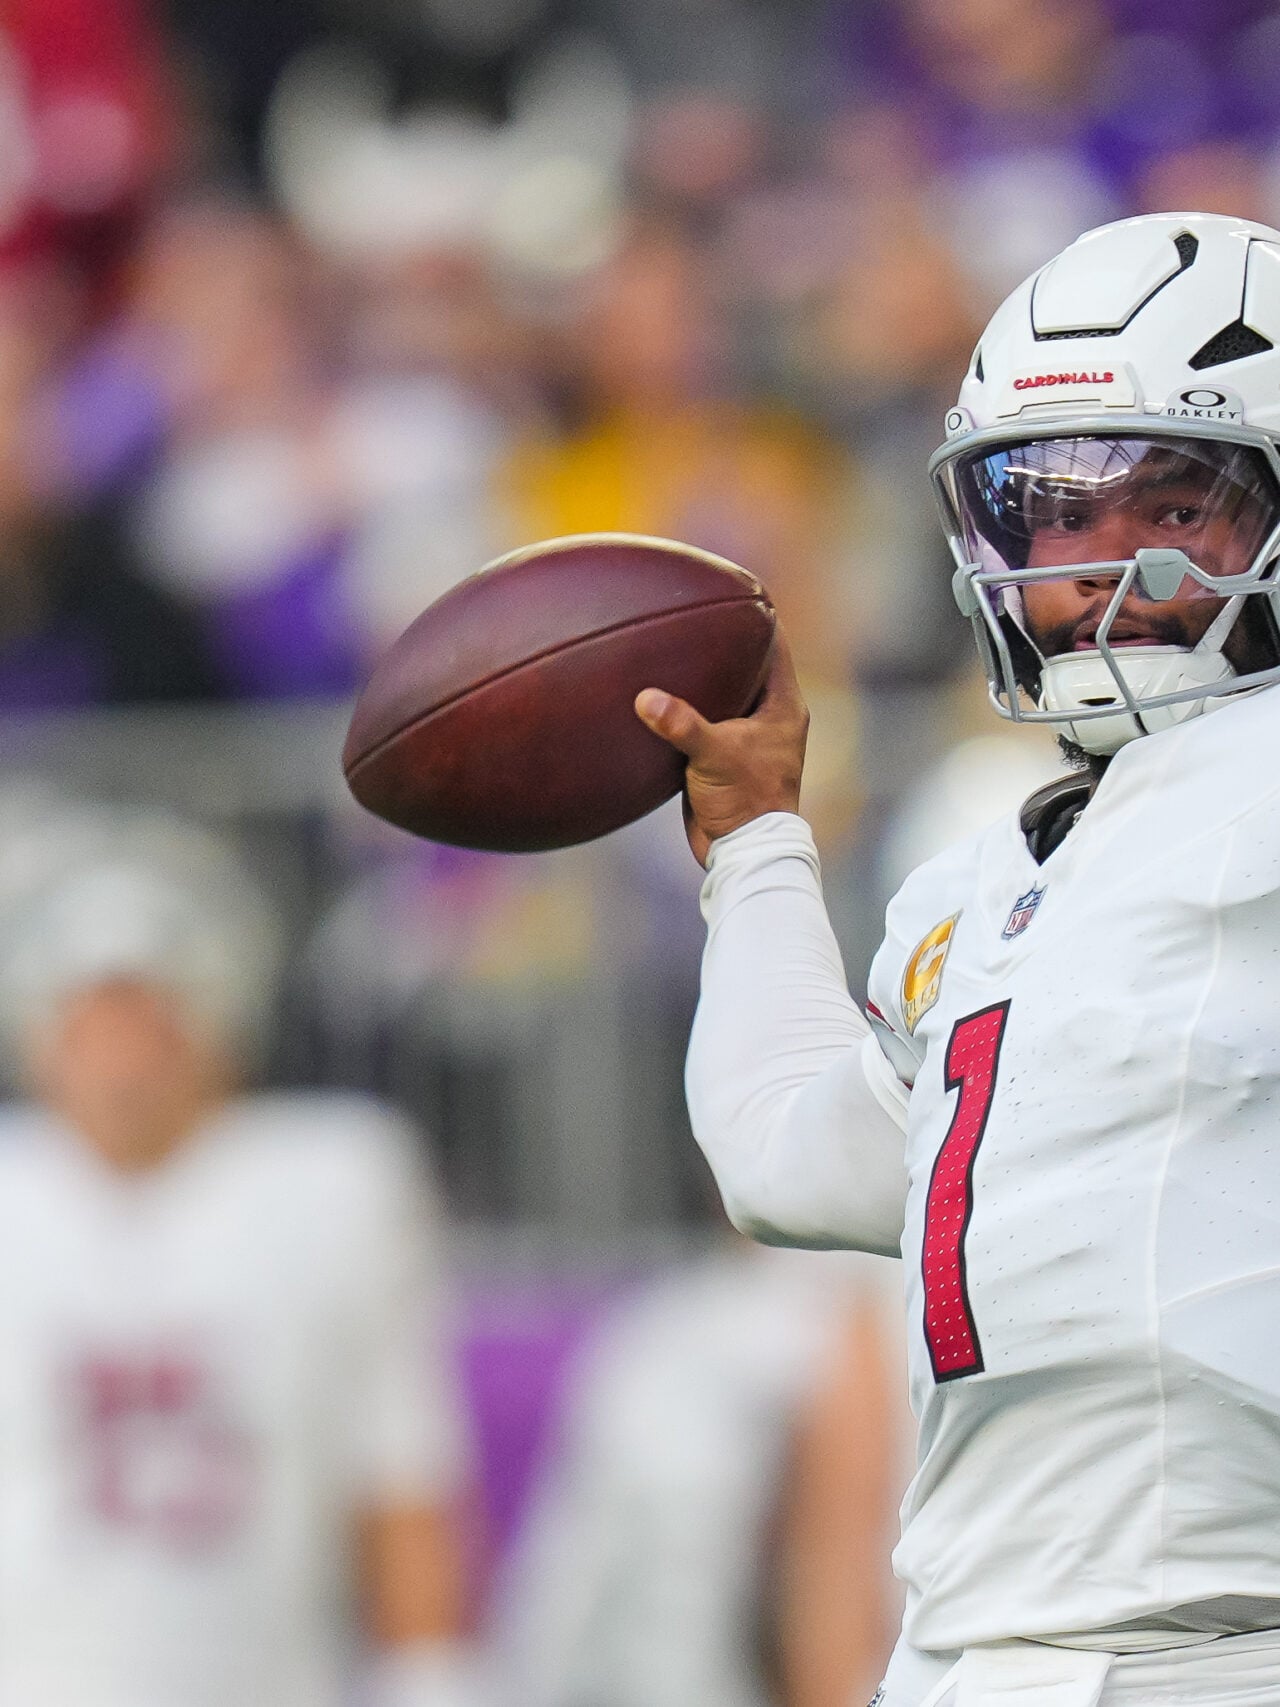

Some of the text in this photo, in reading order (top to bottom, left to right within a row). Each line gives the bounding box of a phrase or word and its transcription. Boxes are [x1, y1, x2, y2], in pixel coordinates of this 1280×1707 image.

[1013, 371, 1114, 390] CARDINALS
[1167, 408, 1237, 419] OAKLEY
[922, 998, 1012, 1384] 1
